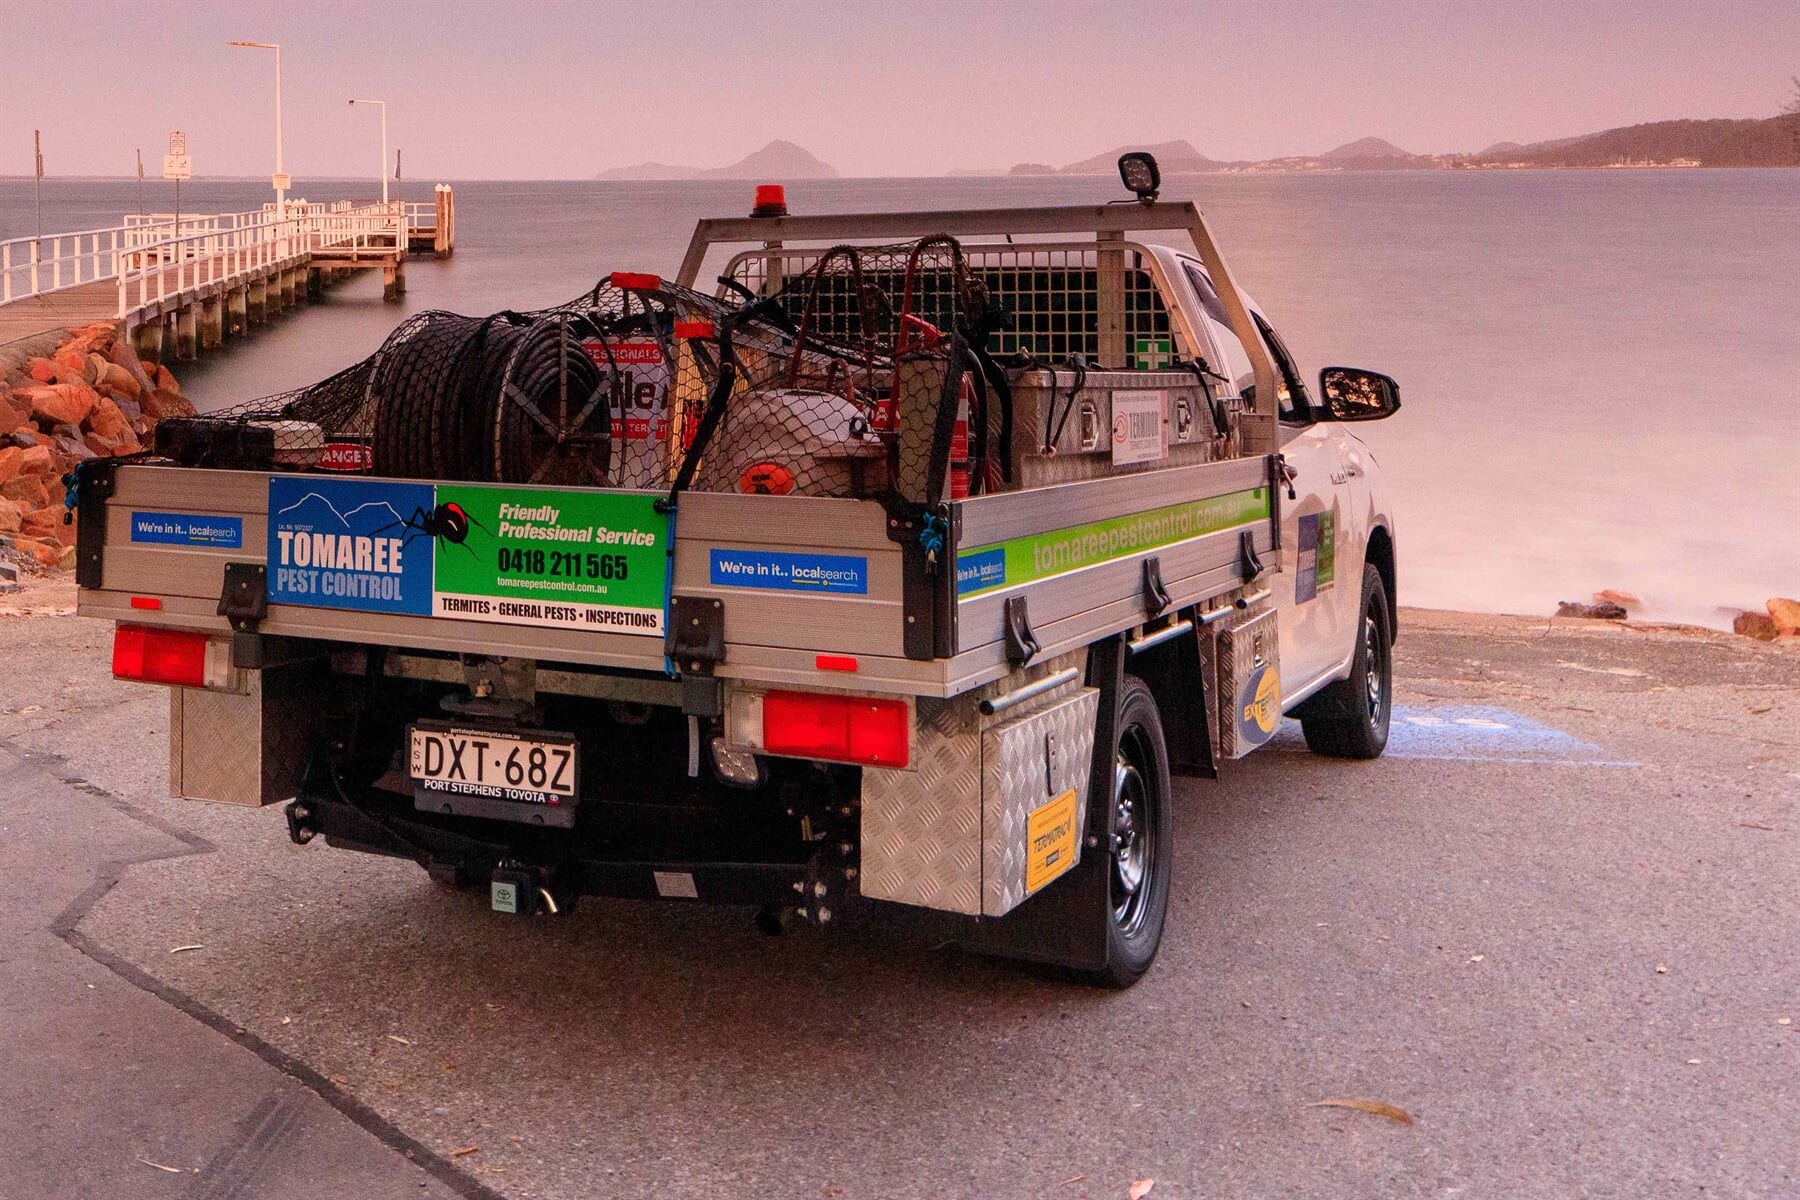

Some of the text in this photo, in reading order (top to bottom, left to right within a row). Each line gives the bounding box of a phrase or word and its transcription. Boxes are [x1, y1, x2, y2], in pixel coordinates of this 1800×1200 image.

[498, 503, 560, 525] Friendly
[138, 522, 163, 533] We're
[165, 523, 173, 533] in
[189, 525, 236, 537] localsearch
[498, 522, 656, 546] Professional Service
[1033, 500, 1240, 574] tomareepestcontrol.com.au
[277, 531, 403, 574] TOMAREE
[498, 548, 628, 580] 0418 211 565
[719, 560, 755, 577] We're
[757, 563, 769, 576] in
[791, 565, 858, 581] localsearch
[277, 568, 403, 601] PEST CONTROL
[497, 576, 608, 594] tomareepestcontrol.com.au
[442, 598, 657, 628] TERMITES GENERAL PESTS INSPECTIONS
[424, 779, 546, 803] PORT STEPHENS TOYOTA
